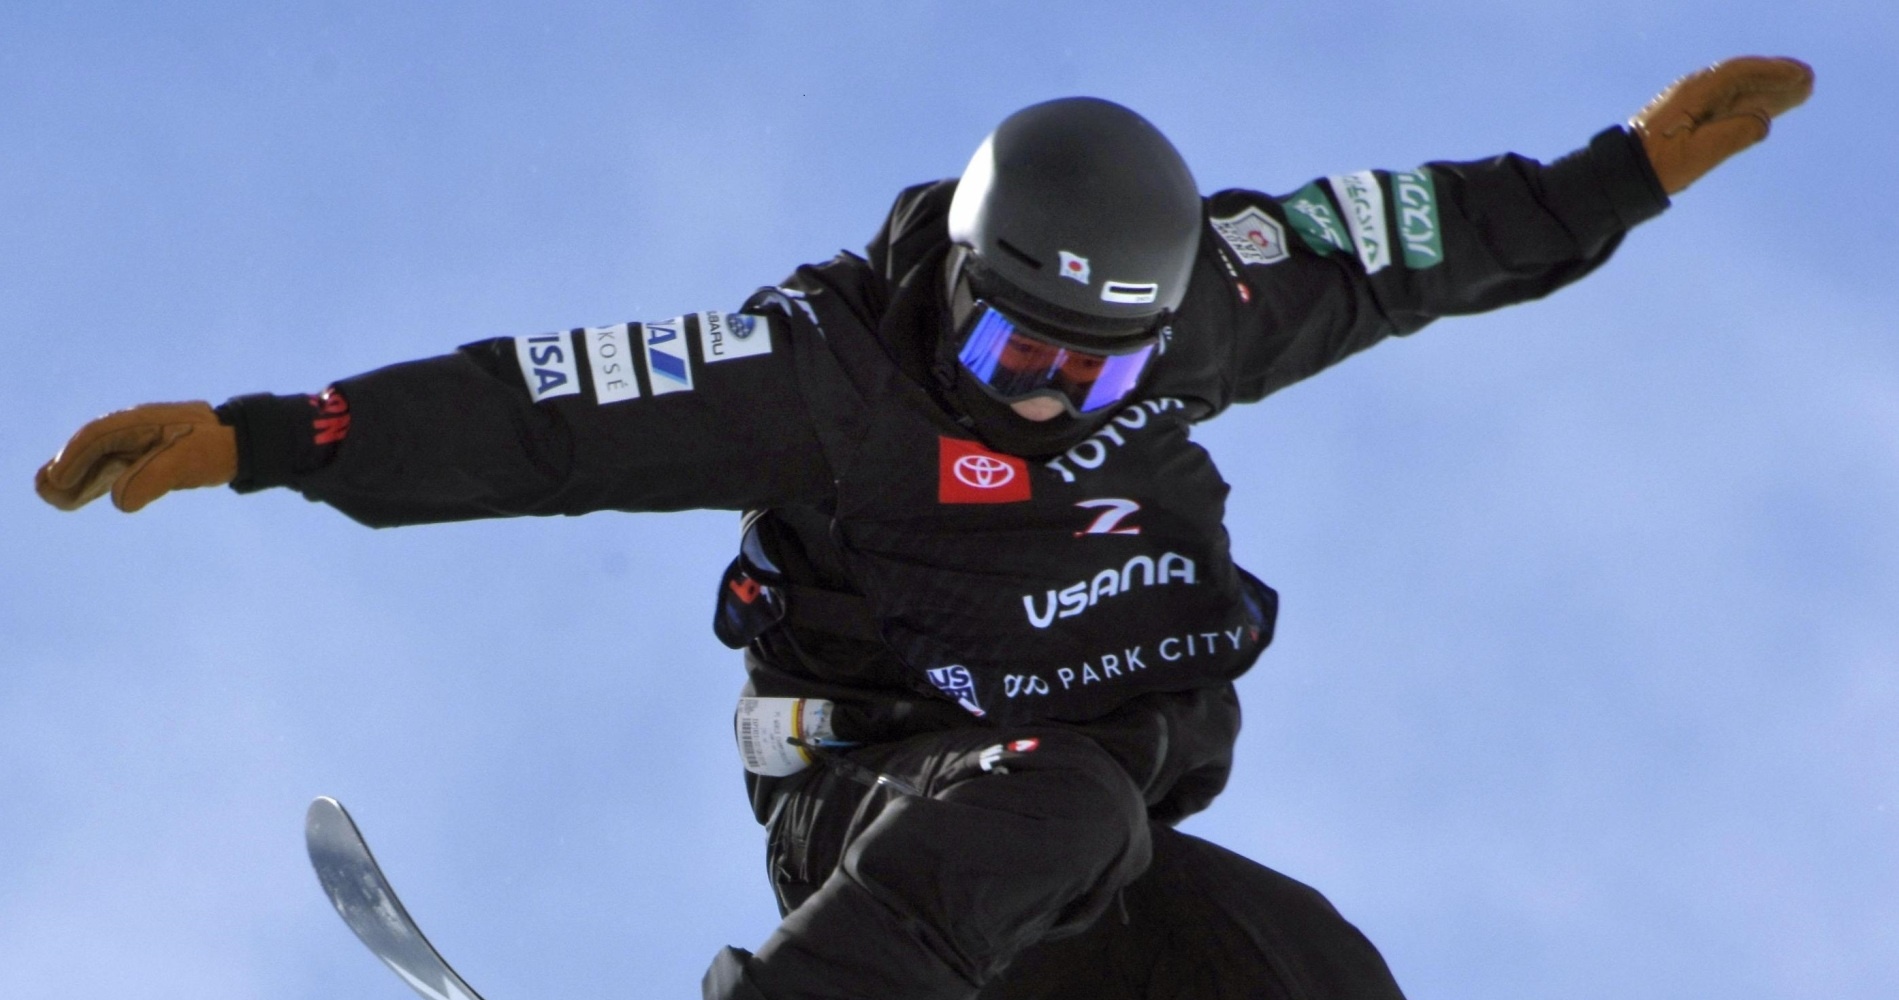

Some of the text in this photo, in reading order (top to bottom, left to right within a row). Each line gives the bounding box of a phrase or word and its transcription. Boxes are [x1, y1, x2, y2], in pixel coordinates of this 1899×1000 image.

[527, 333, 568, 395] ISA
[598, 331, 629, 391] KOSÉ
[1023, 552, 1197, 629] USANA
[1057, 626, 1244, 690] PARK CITY
